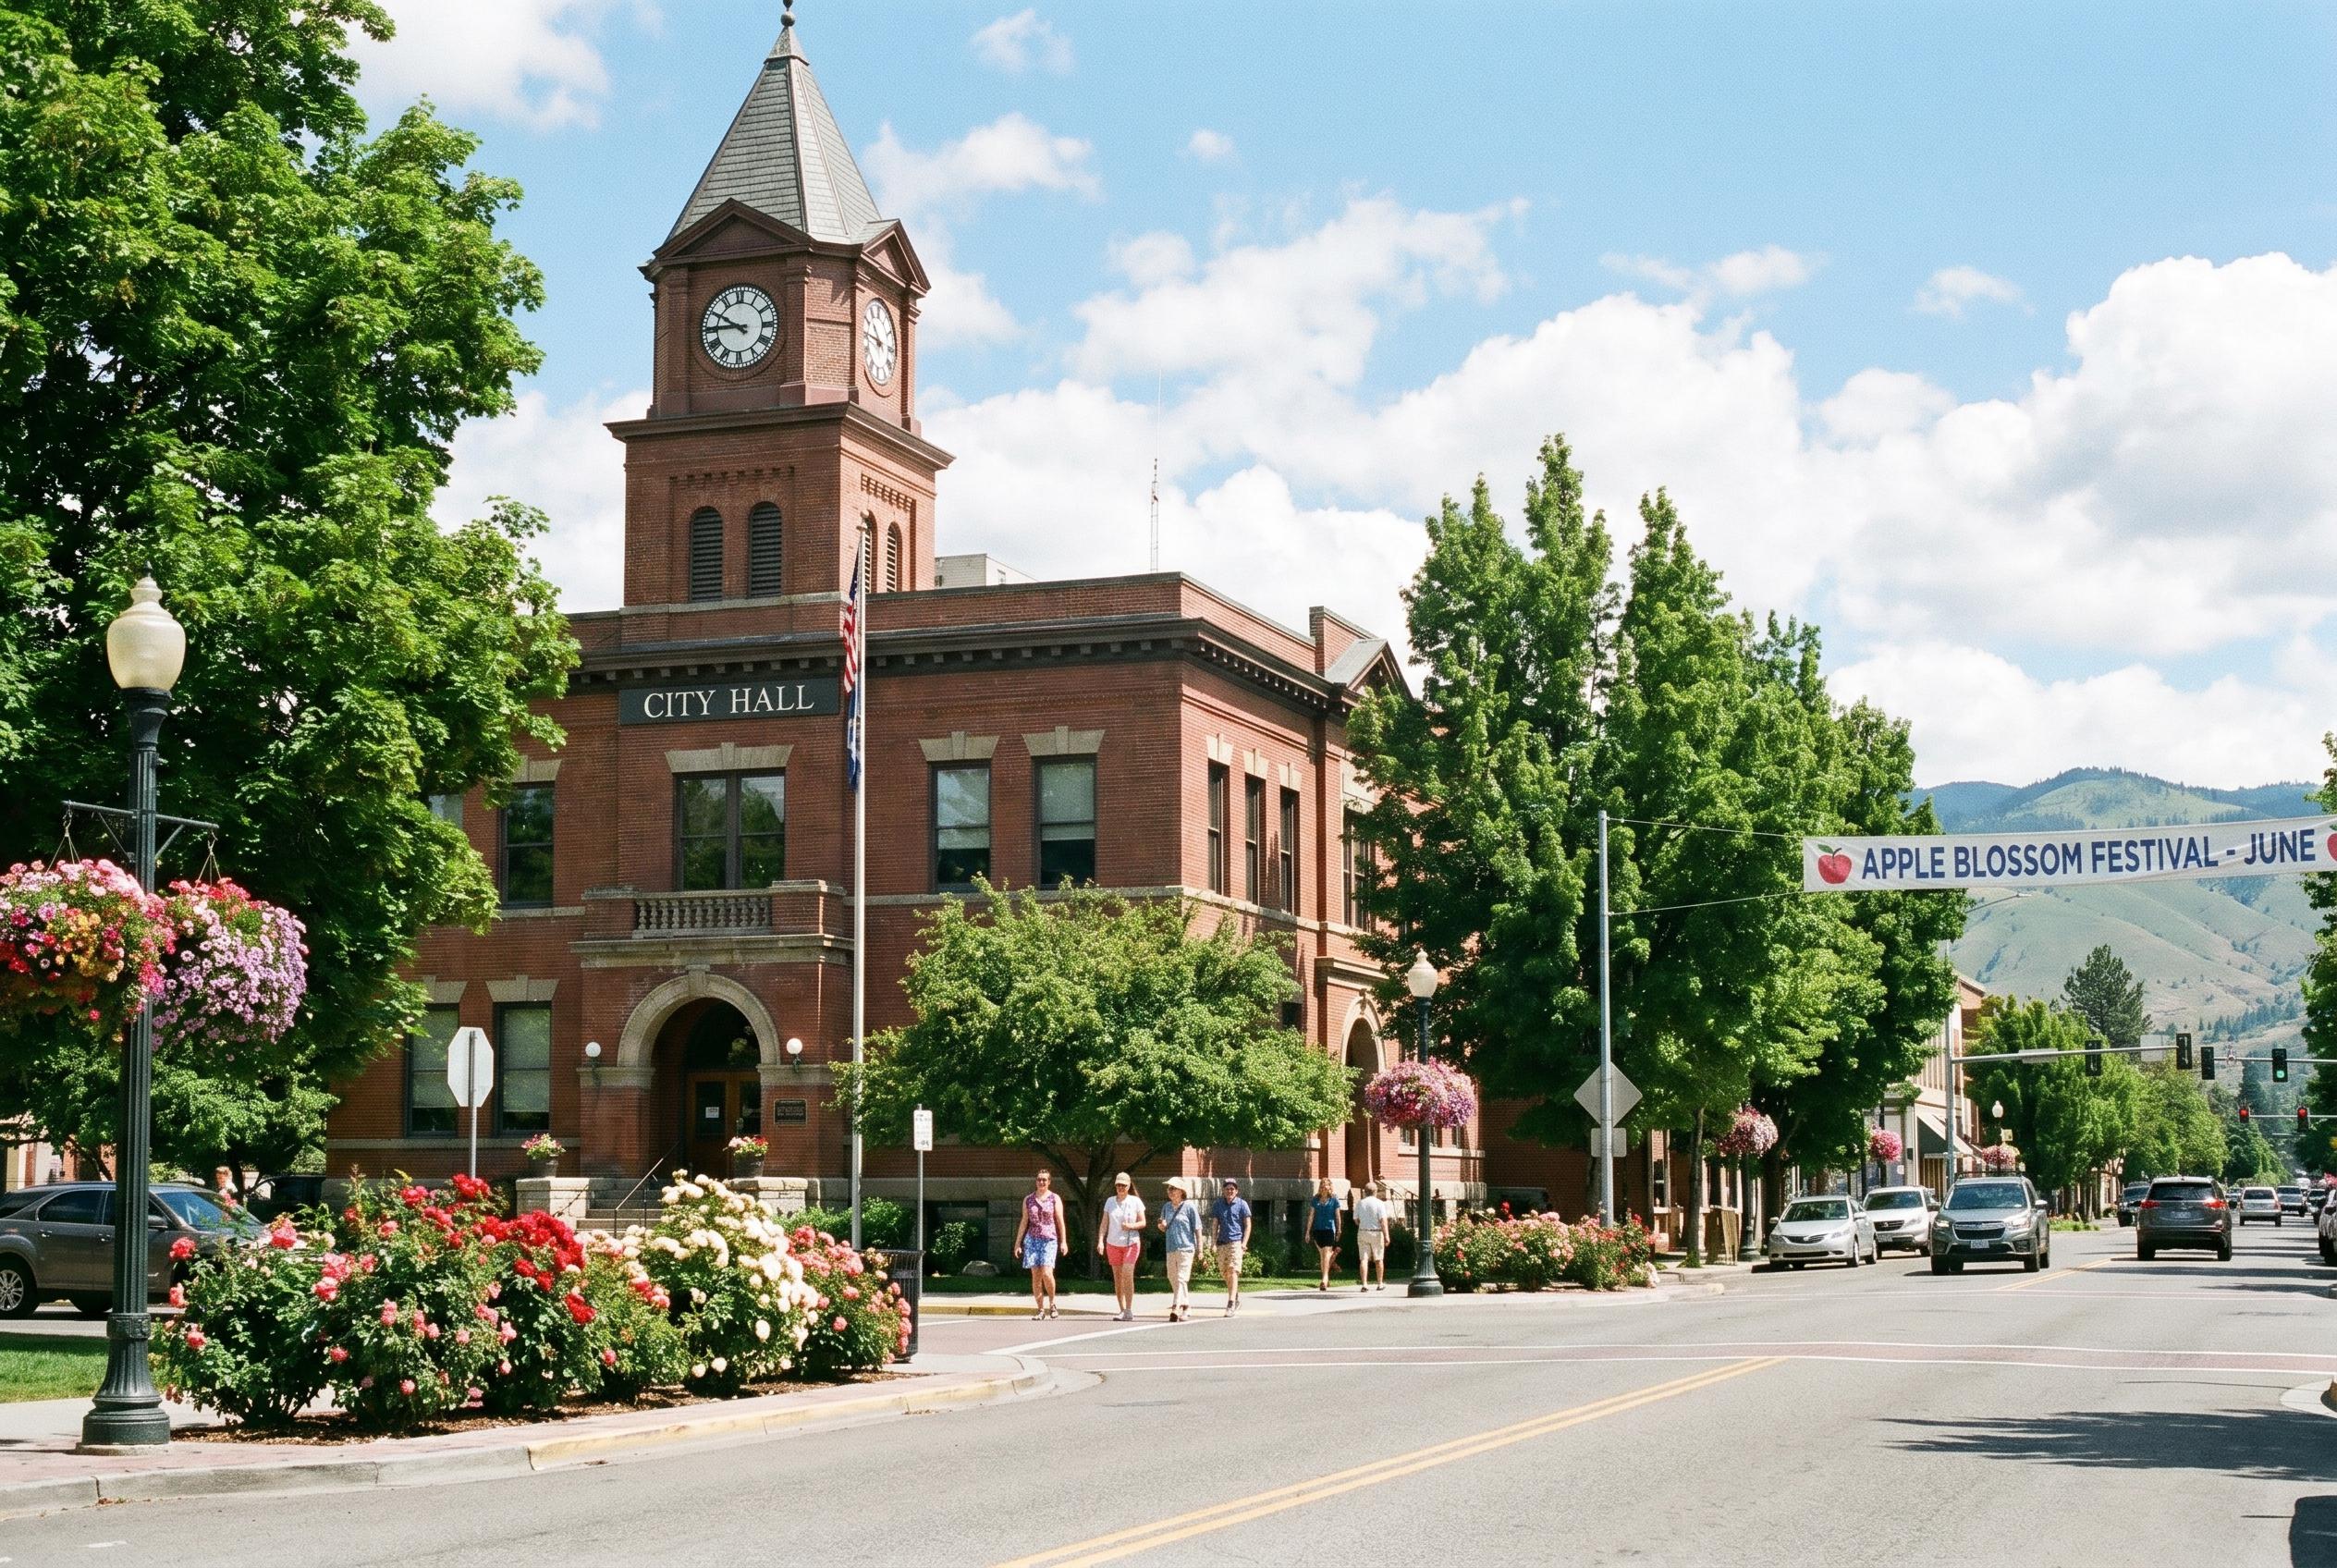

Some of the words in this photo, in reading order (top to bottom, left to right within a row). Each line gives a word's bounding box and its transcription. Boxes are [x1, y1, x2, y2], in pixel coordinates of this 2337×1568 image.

[643, 689, 716, 718] CITY
[729, 683, 814, 714] HALL
[1862, 846, 1946, 880] APPLE
[1953, 841, 2083, 878] BLOSSOM
[2090, 835, 2219, 874] FESTIVAL
[2226, 848, 2236, 856] -
[2244, 828, 2316, 865] JUNE
